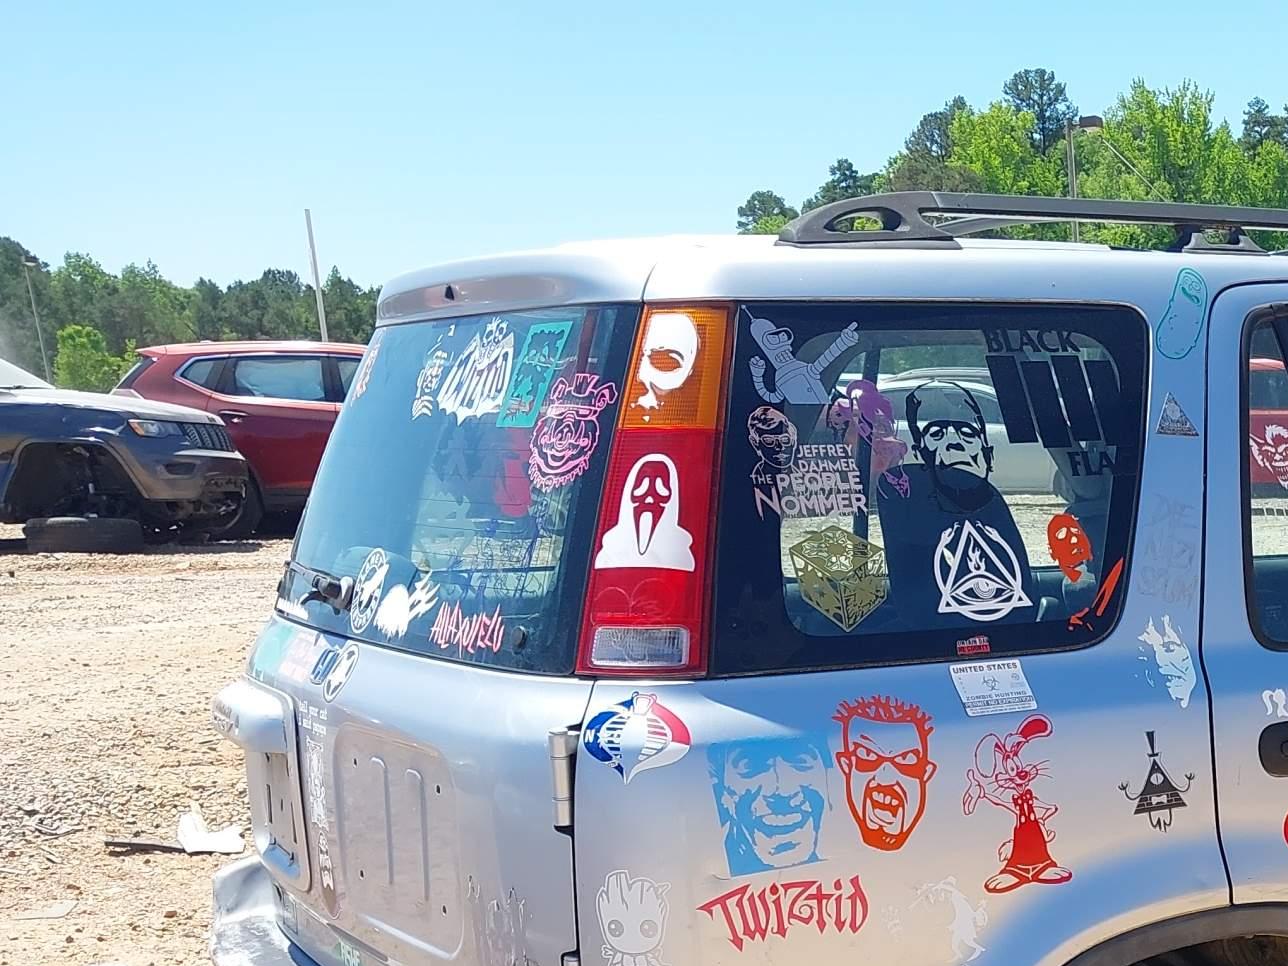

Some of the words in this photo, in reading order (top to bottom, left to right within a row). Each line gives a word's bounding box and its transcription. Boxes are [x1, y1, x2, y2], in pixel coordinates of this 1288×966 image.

[982, 329, 1081, 352] BLACK
[797, 443, 853, 458] JEFFREY
[798, 459, 859, 472] DAHMER
[1066, 450, 1116, 477] FLA
[750, 474, 774, 485] THE
[776, 472, 863, 495] PEOPLE
[754, 485, 868, 520] NOMMER
[952, 665, 985, 674] UNITED
[986, 662, 1018, 672] STATES
[966, 693, 994, 701] ZOMBIE
[994, 690, 1027, 699] HUNTING
